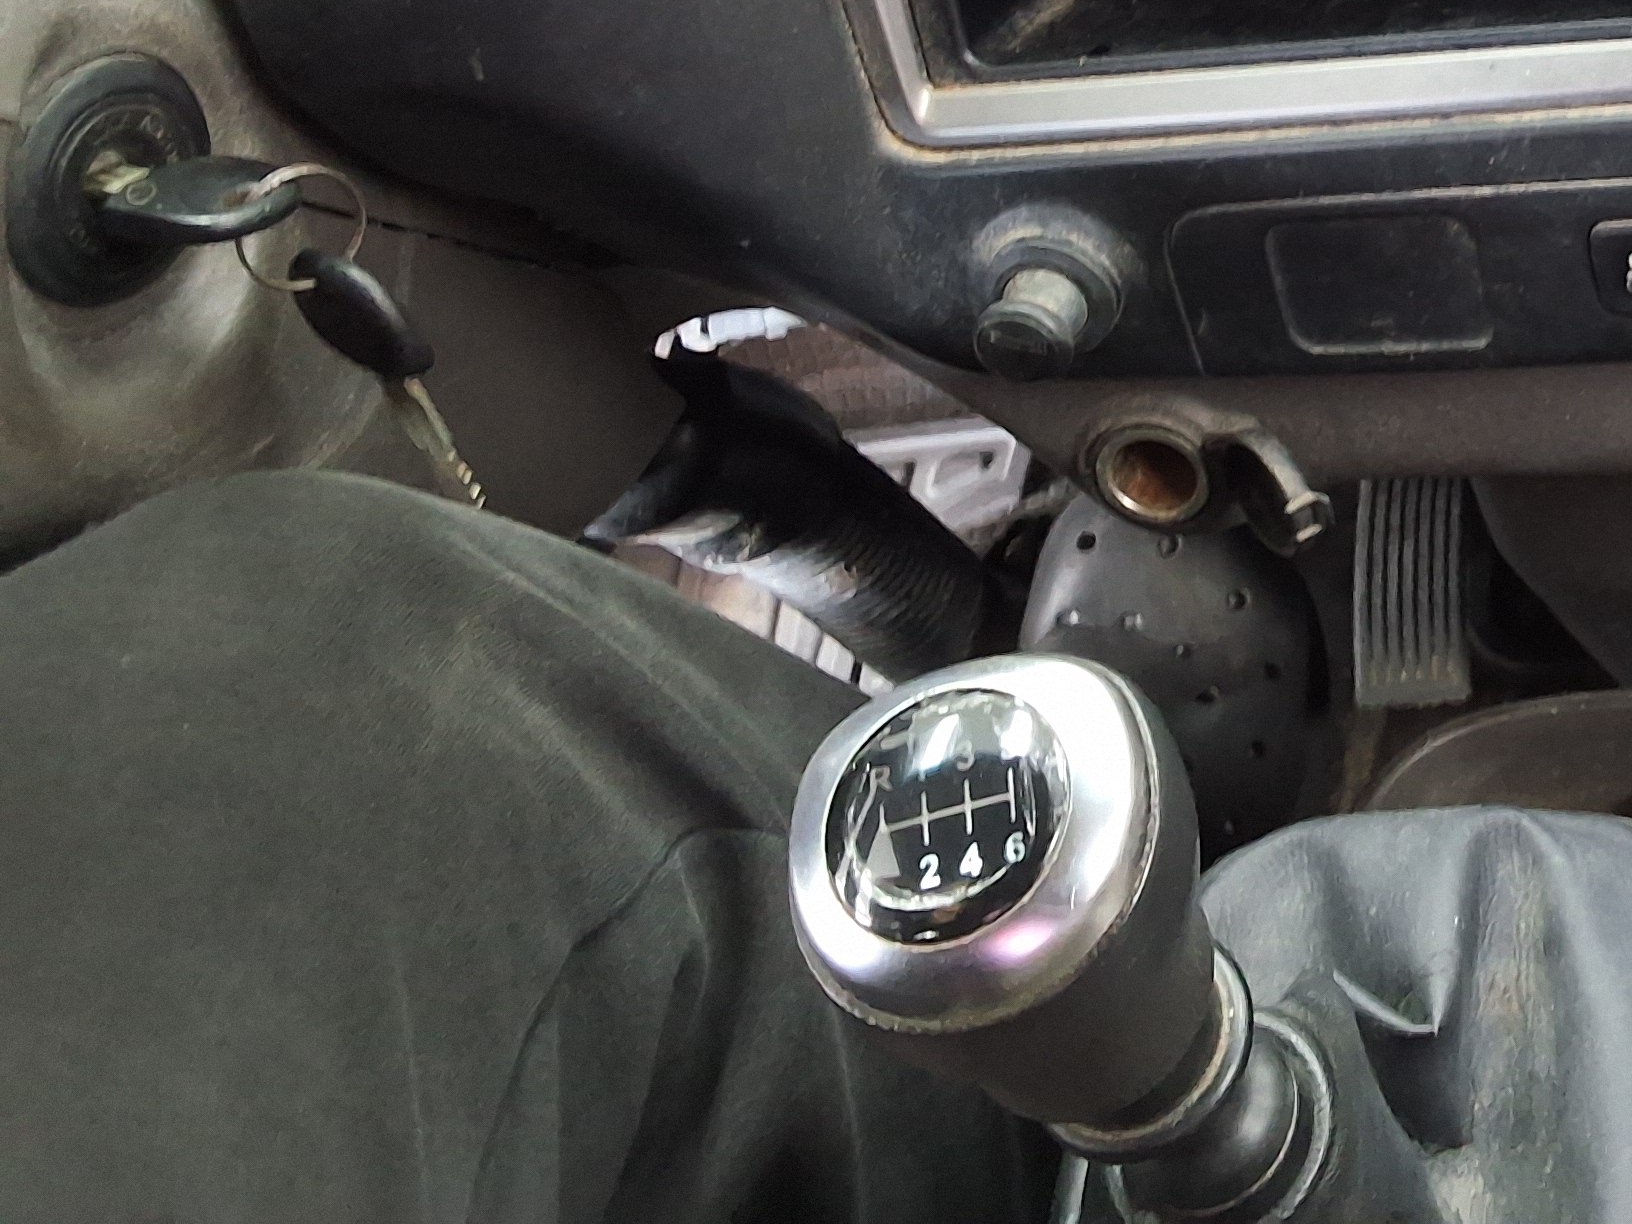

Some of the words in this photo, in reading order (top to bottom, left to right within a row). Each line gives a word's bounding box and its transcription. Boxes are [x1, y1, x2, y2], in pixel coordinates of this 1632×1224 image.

[959, 841, 984, 877] 4
[1004, 831, 1027, 863] 6
[918, 852, 942, 890] 2
